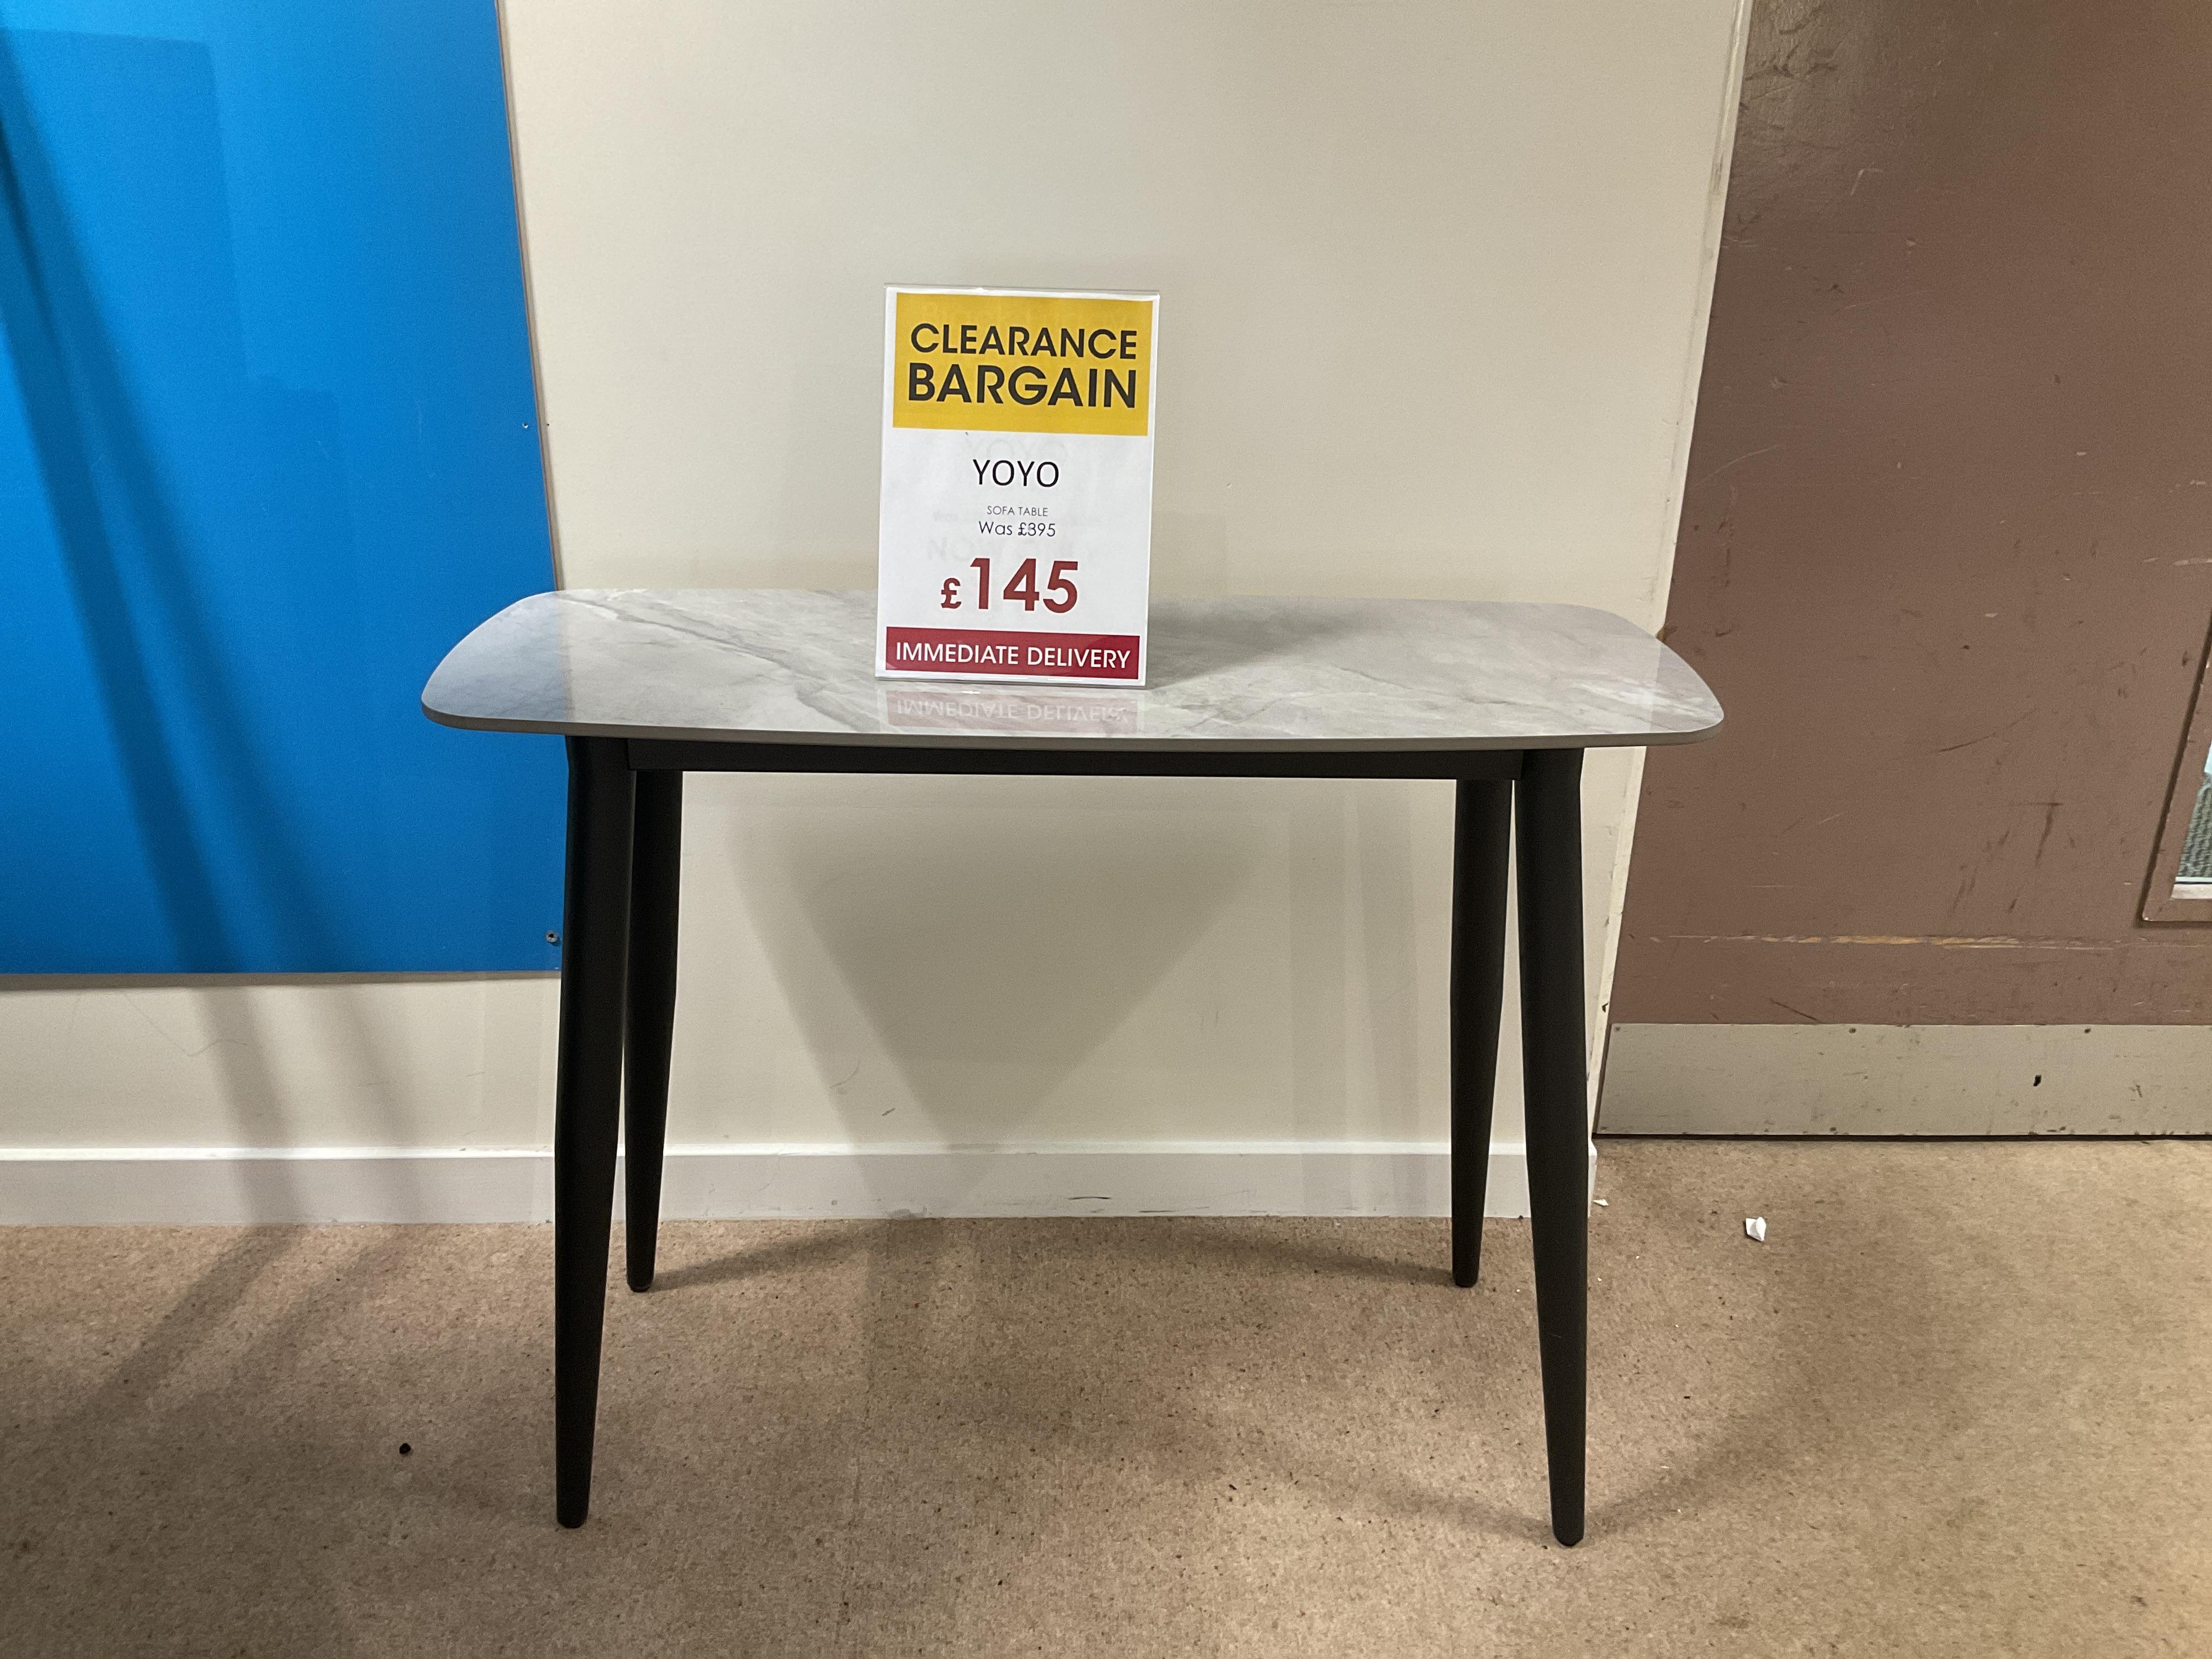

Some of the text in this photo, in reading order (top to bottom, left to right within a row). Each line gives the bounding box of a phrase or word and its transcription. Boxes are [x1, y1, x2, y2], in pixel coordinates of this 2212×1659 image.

[911, 323, 1137, 359] CLEARANCE
[909, 362, 1136, 408] BARGAIN
[973, 459, 1059, 488] YOYO
[987, 505, 1048, 517] SOFA TABLE
[979, 521, 1056, 537] Was £395
[940, 557, 1079, 613] £145
[896, 642, 1131, 669] IMMEDIATE DELIVERY
